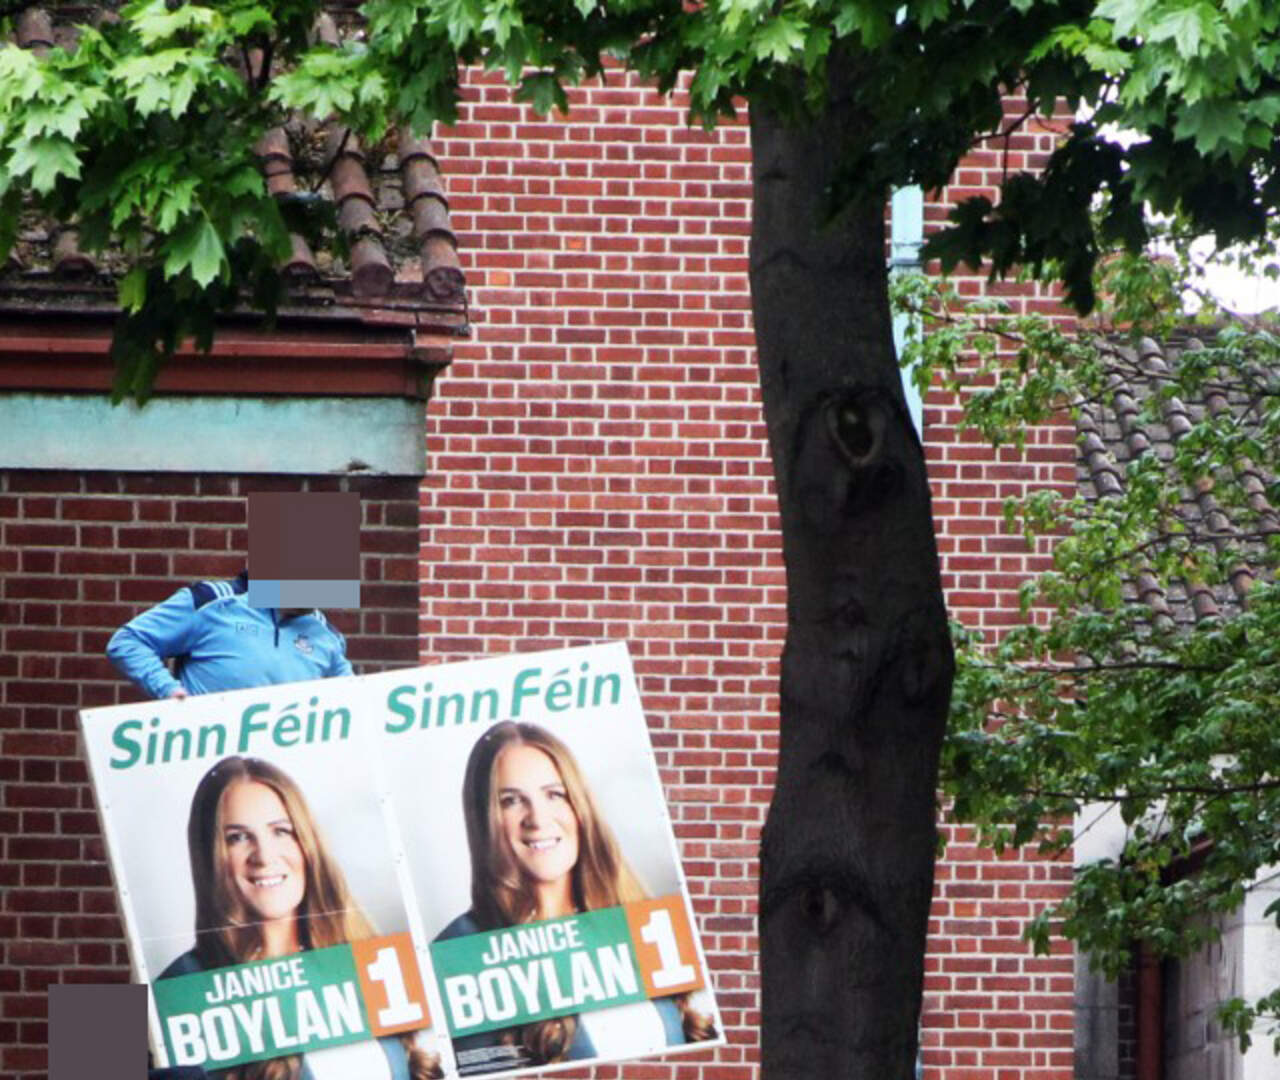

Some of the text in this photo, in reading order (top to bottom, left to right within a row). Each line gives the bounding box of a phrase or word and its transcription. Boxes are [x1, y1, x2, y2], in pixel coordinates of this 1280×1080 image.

[109, 695, 351, 770] Sinn Féin
[385, 661, 621, 733] Sinn Féin
[205, 957, 309, 1004] JANICE
[480, 919, 584, 966] JANICE
[639, 908, 697, 989] 1
[166, 981, 365, 1067] BOYLAN
[366, 946, 424, 1028] 1
[443, 942, 640, 1030] BOYLAN
